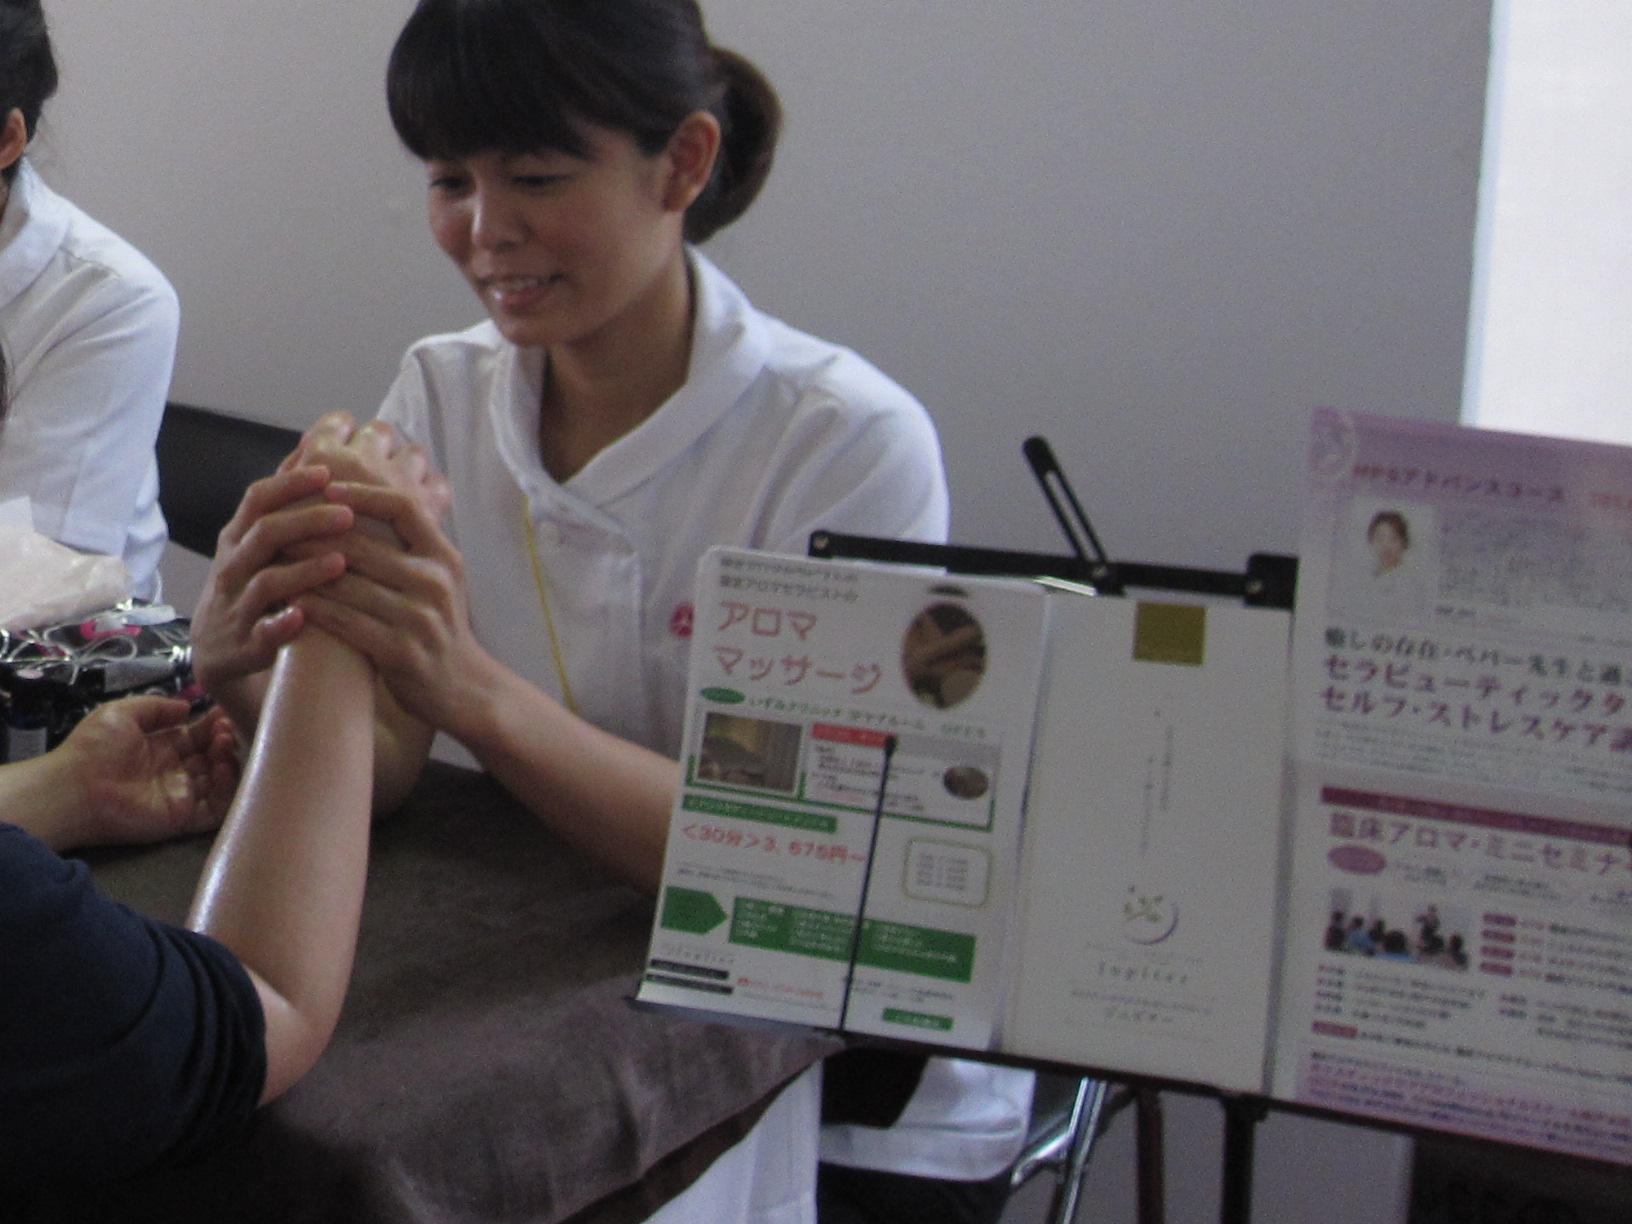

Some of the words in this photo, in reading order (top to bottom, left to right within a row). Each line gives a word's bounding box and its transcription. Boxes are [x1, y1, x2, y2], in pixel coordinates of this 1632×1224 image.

[718, 600, 817, 641] アロマ
[713, 645, 884, 695] マッサージ
